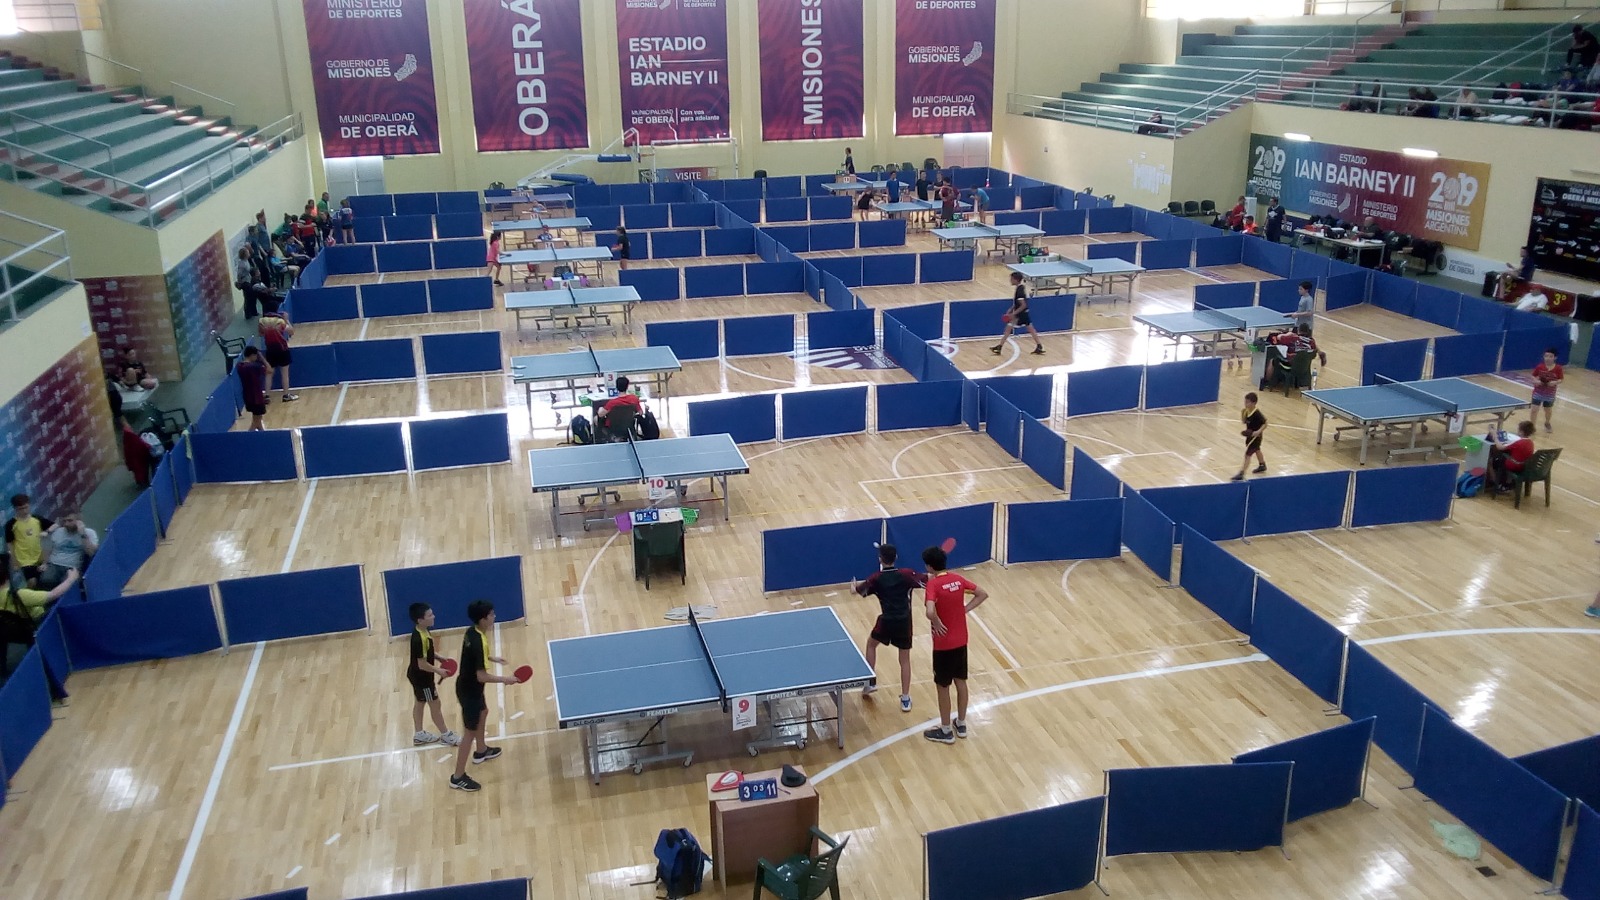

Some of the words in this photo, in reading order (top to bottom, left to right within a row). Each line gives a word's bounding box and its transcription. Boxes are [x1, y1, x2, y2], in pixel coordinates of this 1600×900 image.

[327, 0, 402, 9] MINISTERIO
[915, 1, 928, 9] DE
[930, 1, 977, 9] DEPORTES
[328, 9, 343, 19] DE
[346, 9, 403, 19] DEPORTES
[629, 36, 706, 52] ESTADIO
[908, 46, 948, 54] GOBIERNO
[326, 59, 375, 68] GOBIERNO
[377, 59, 389, 67] DE
[630, 54, 662, 70] IAN
[908, 54, 960, 63] MISIONES
[328, 67, 391, 78] MISIONES
[631, 71, 704, 86] BARNEY
[708, 70, 718, 85] II
[912, 94, 975, 104] MUNICIPALIDAD
[912, 107, 929, 118] DE
[932, 102, 976, 117] OBERÁ
[339, 113, 415, 123] MUNICIPALIDAD
[631, 116, 643, 124] DE
[341, 126, 361, 139] DE
[365, 121, 418, 138] OBERÁ
[1339, 154, 1367, 165] ESTADIO
[675, 171, 702, 180] VISITE
[1295, 158, 1322, 181] IAN
[1325, 163, 1401, 194] BARNEY
[1403, 175, 1416, 198] II
[1308, 196, 1338, 208] MISIONES
[1363, 200, 1398, 213] MINISTERIO
[1370, 210, 1397, 220] DEPORTES
[1426, 209, 1470, 226] MISIONES
[1424, 221, 1468, 236] ARGENTINA
[650, 479, 664, 489] 10
[652, 512, 657, 520] 8
[738, 699, 750, 713] 9
[743, 786, 750, 798] 3
[767, 783, 777, 796] 11
